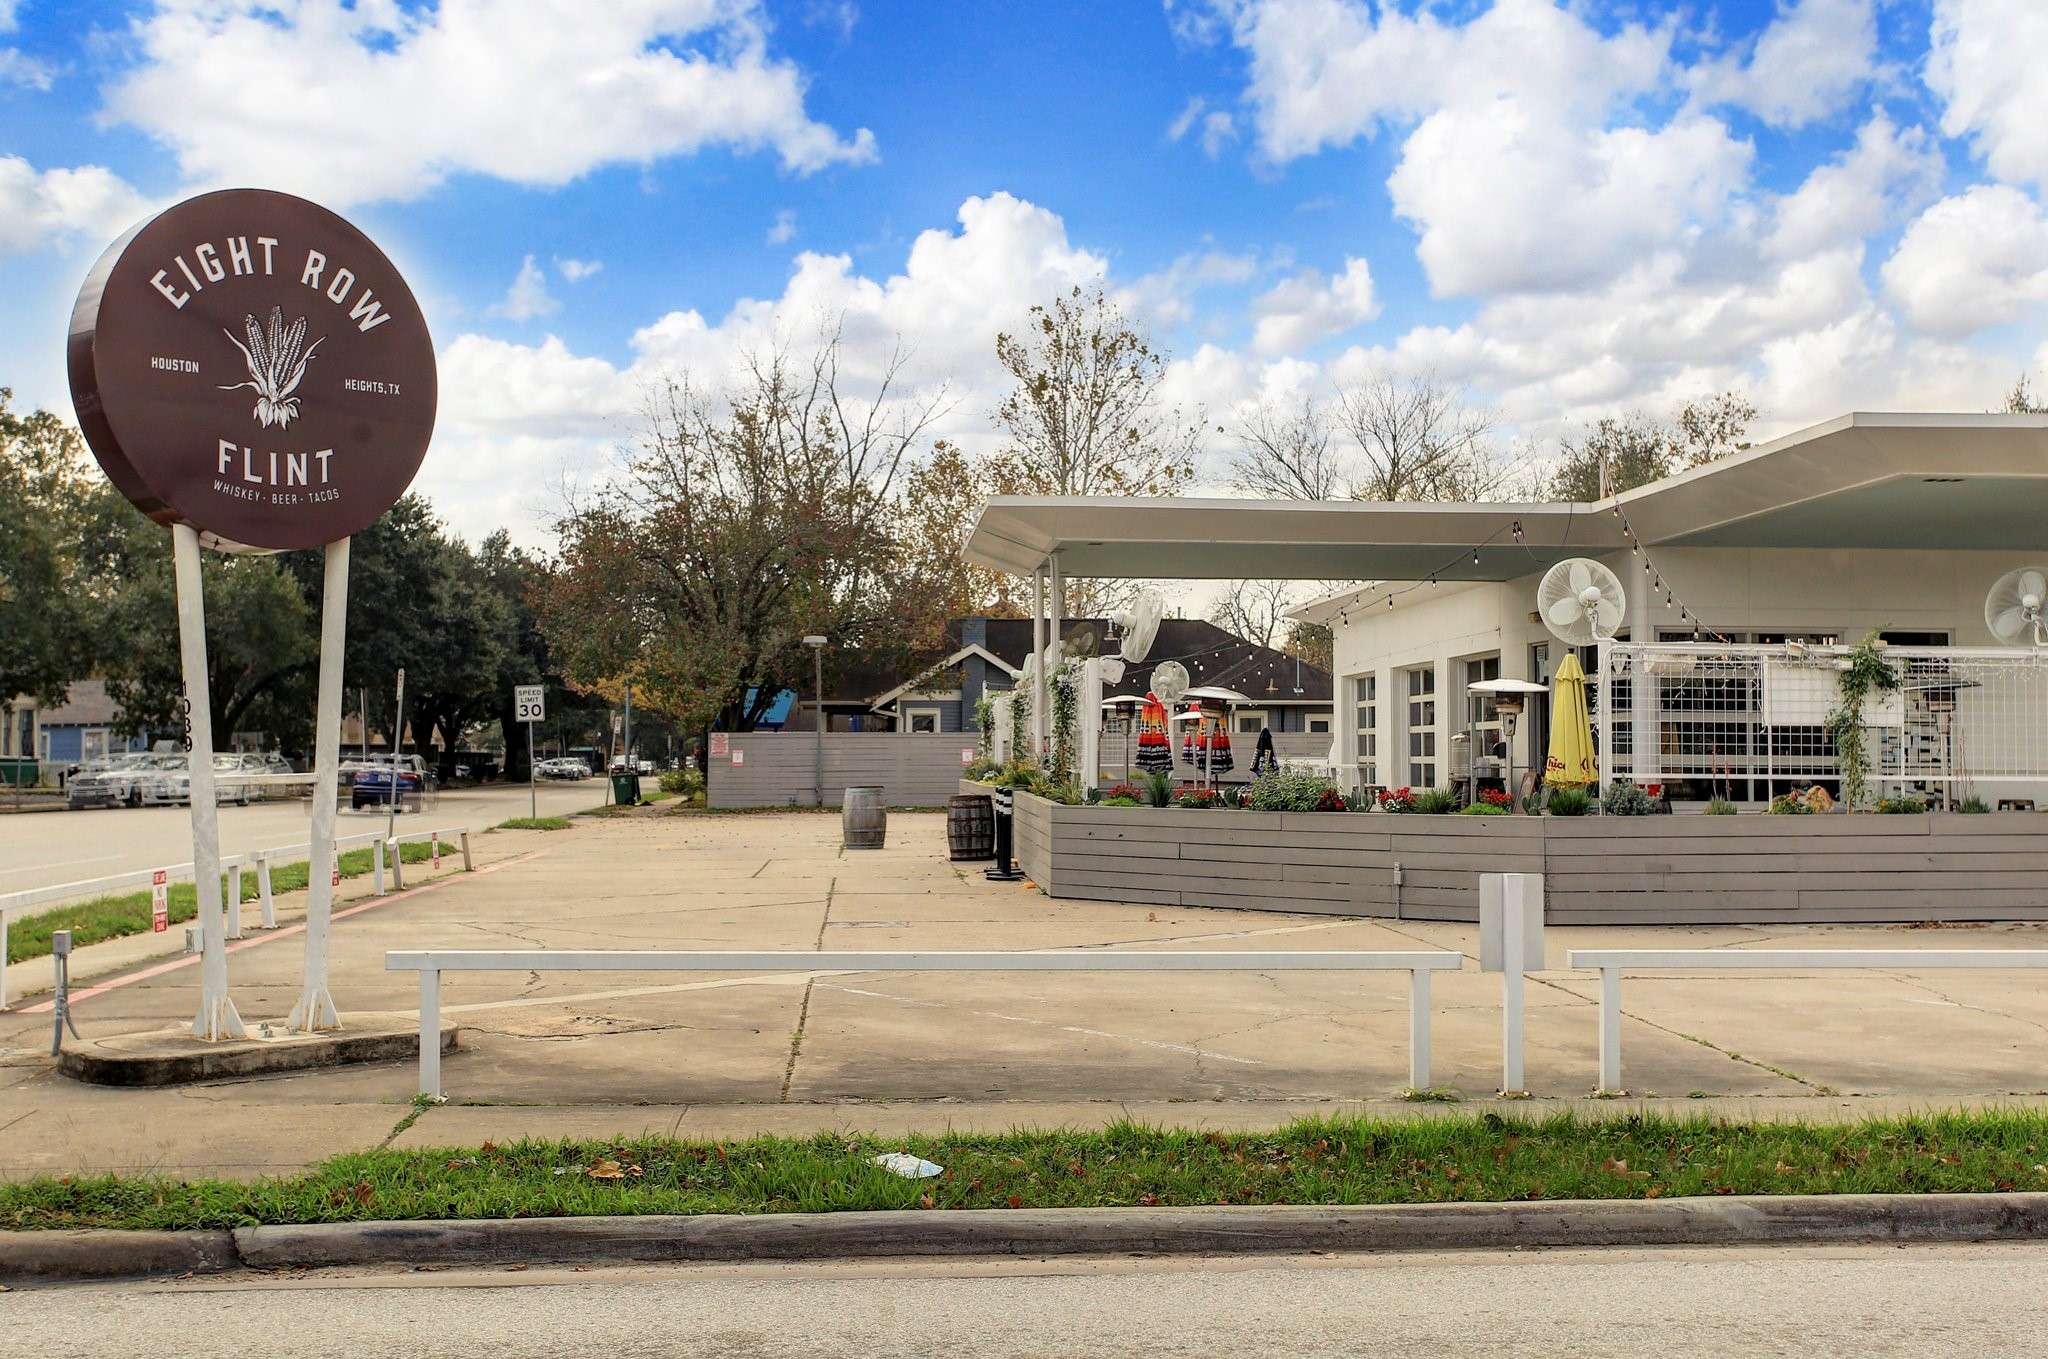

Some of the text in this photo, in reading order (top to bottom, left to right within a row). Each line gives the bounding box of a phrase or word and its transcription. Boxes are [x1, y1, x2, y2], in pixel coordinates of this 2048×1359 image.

[150, 236, 391, 333] EIGHT ROW
[151, 356, 200, 373] HOUSTON
[218, 438, 334, 486] FLINT
[213, 479, 340, 505] WHISKEY BEER TACOS
[518, 689, 542, 697] SPEED
[519, 704, 542, 717] 30
